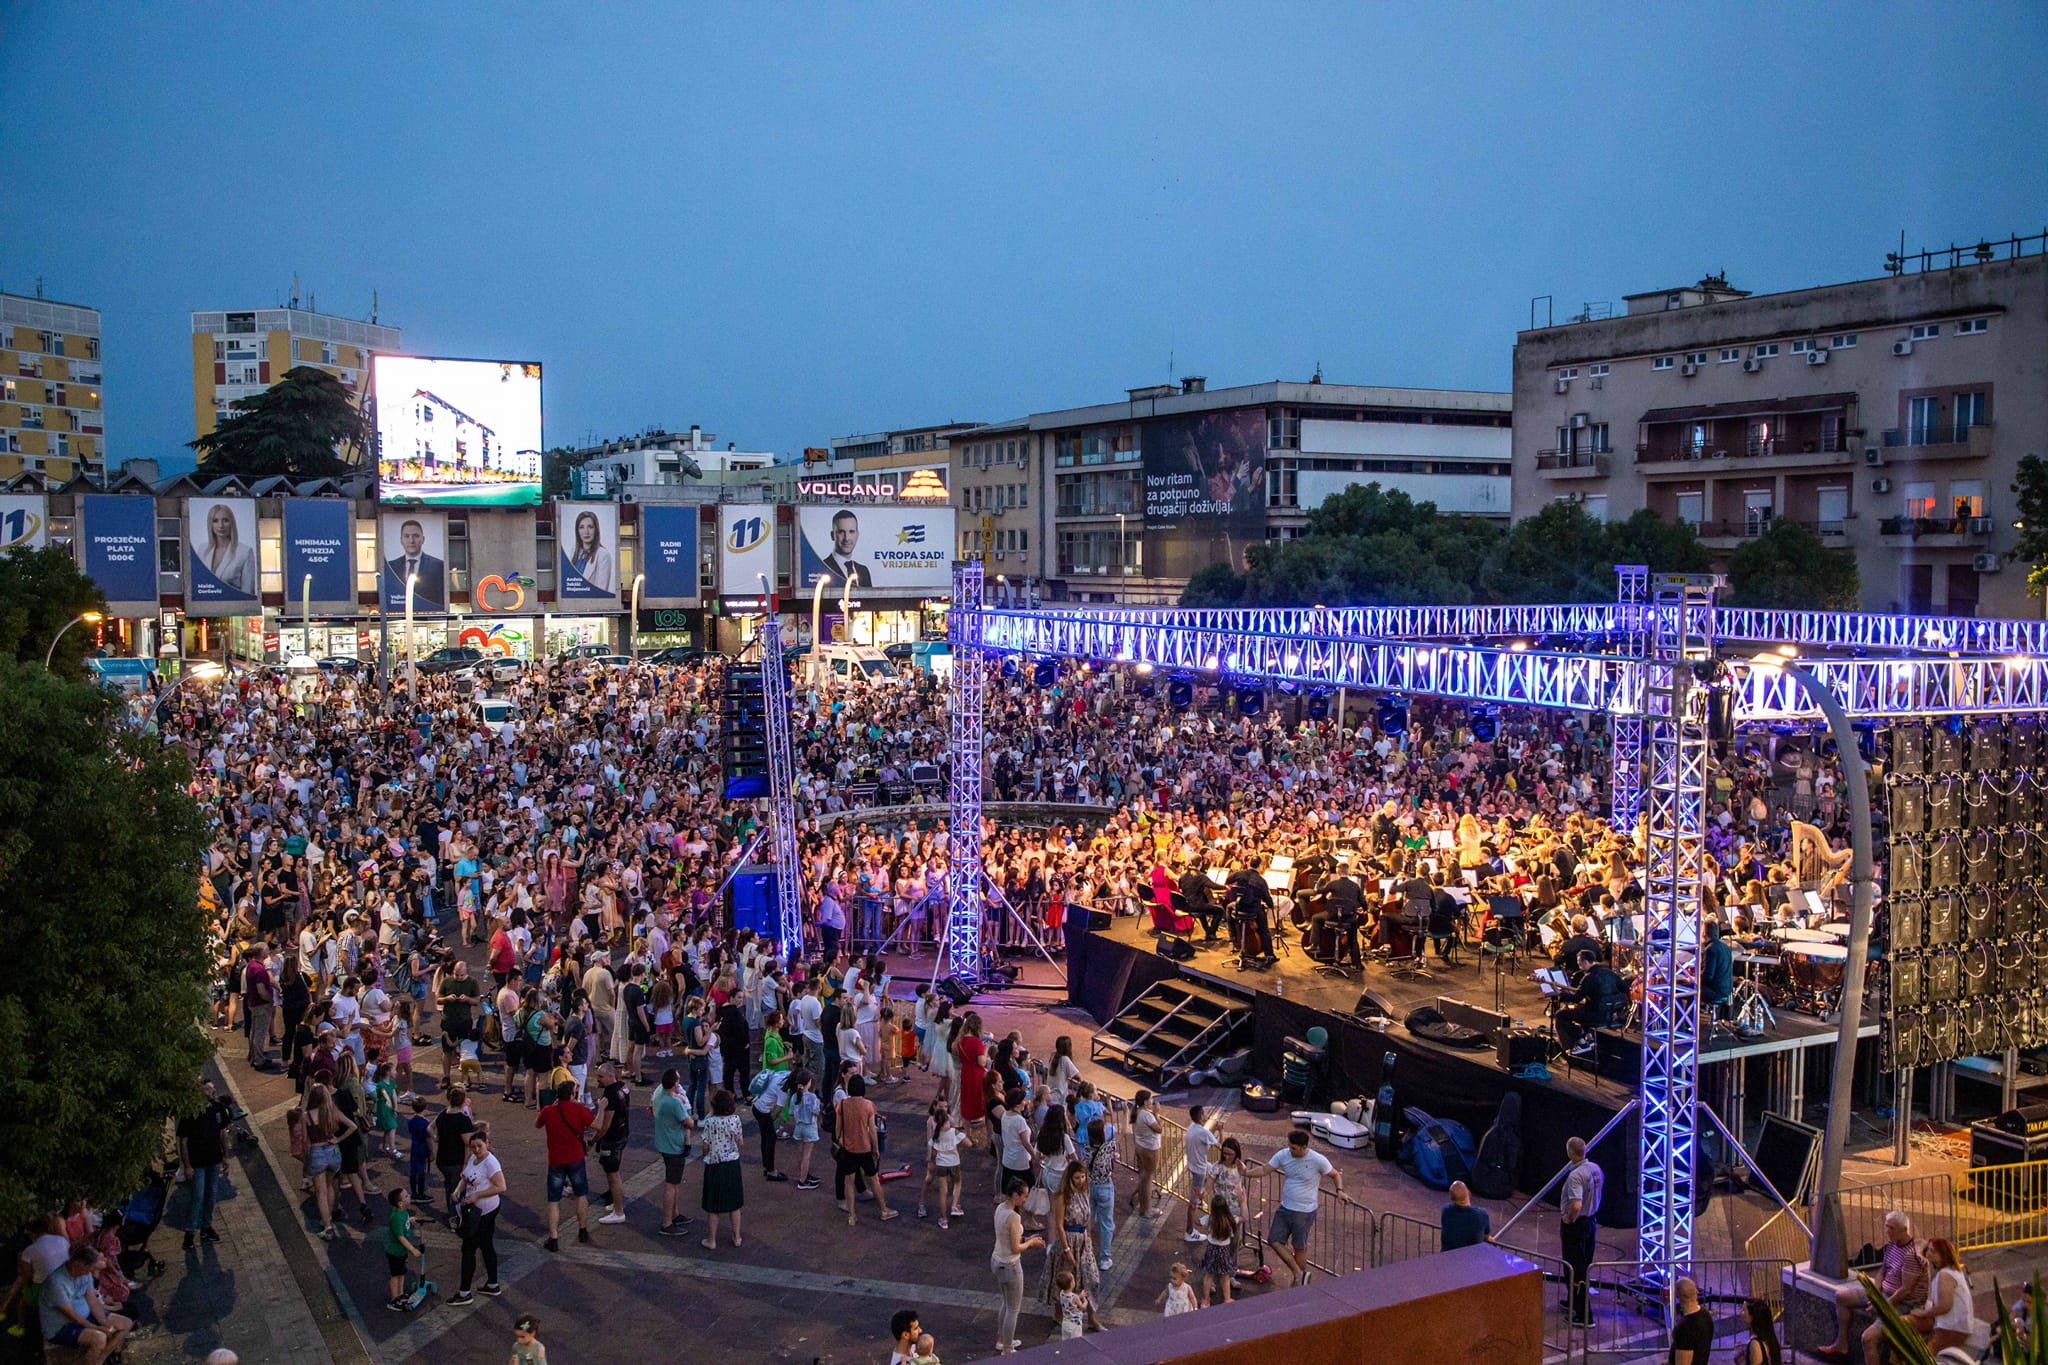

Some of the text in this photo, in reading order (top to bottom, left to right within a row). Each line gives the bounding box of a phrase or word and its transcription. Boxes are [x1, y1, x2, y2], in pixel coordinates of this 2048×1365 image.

[1147, 473, 1192, 486] Nov ritam
[797, 482, 894, 496] VOLCANO
[1147, 488, 1200, 502] za potpuno
[1147, 500, 1233, 516] drugačiji doživljaj.
[0, 509, 25, 545] 1
[733, 517, 761, 548] 11
[94, 536, 146, 544] PROSJEČNA
[874, 551, 945, 560] EVROPA SAD!
[881, 560, 923, 569] VRIJEME
